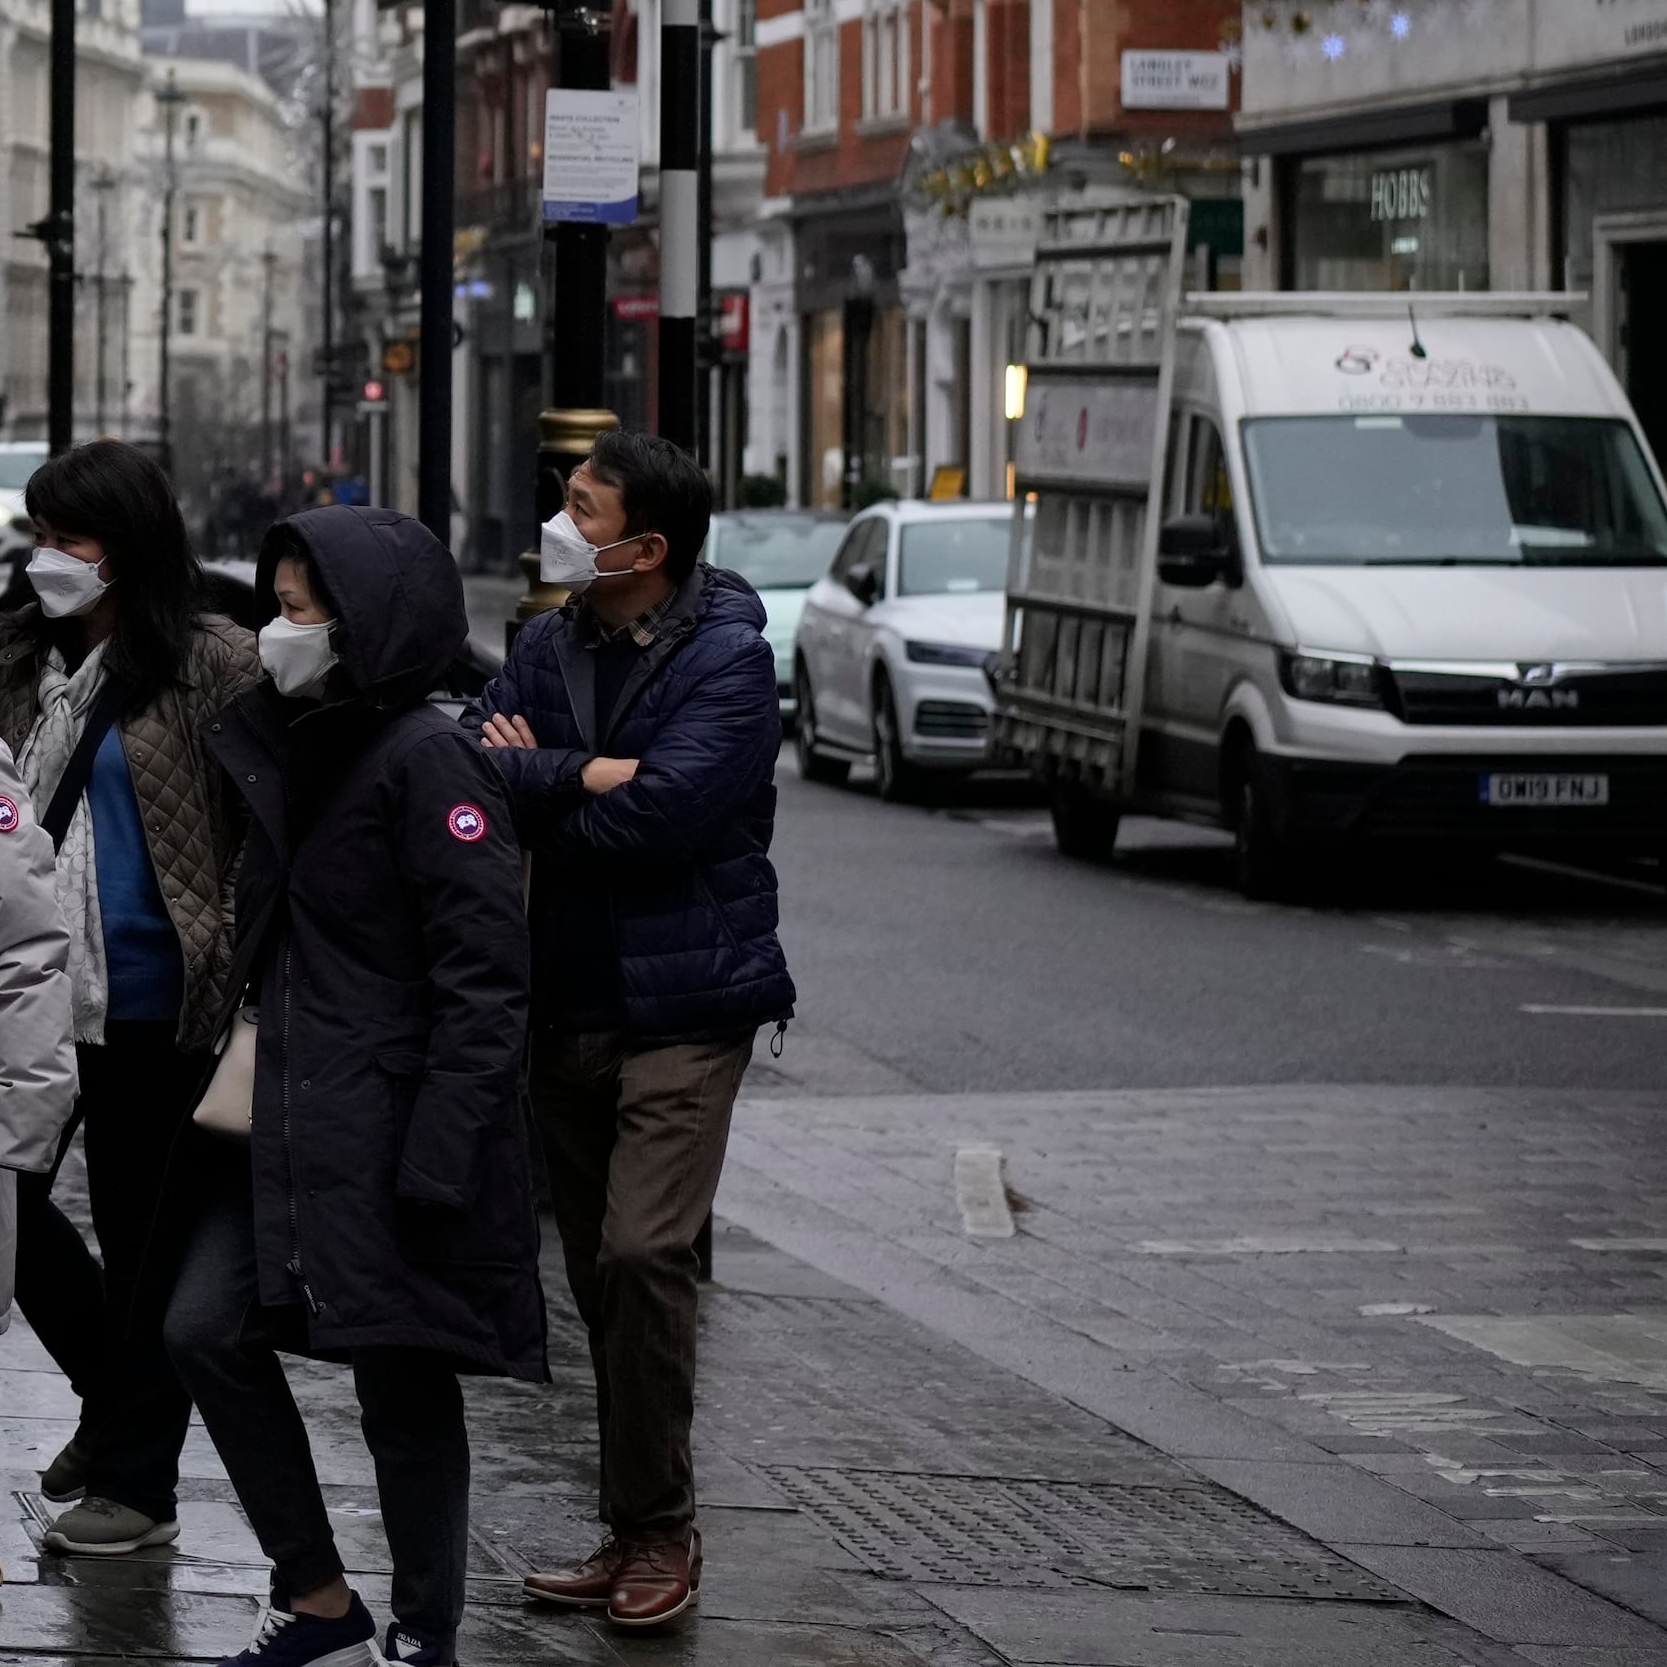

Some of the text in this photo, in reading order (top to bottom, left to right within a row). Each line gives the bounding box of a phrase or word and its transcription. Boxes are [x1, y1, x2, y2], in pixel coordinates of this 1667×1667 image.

[1370, 168, 1430, 222] HOBBS
[1497, 687, 1579, 709] MAN
[397, 1632, 422, 1648] PRADA
